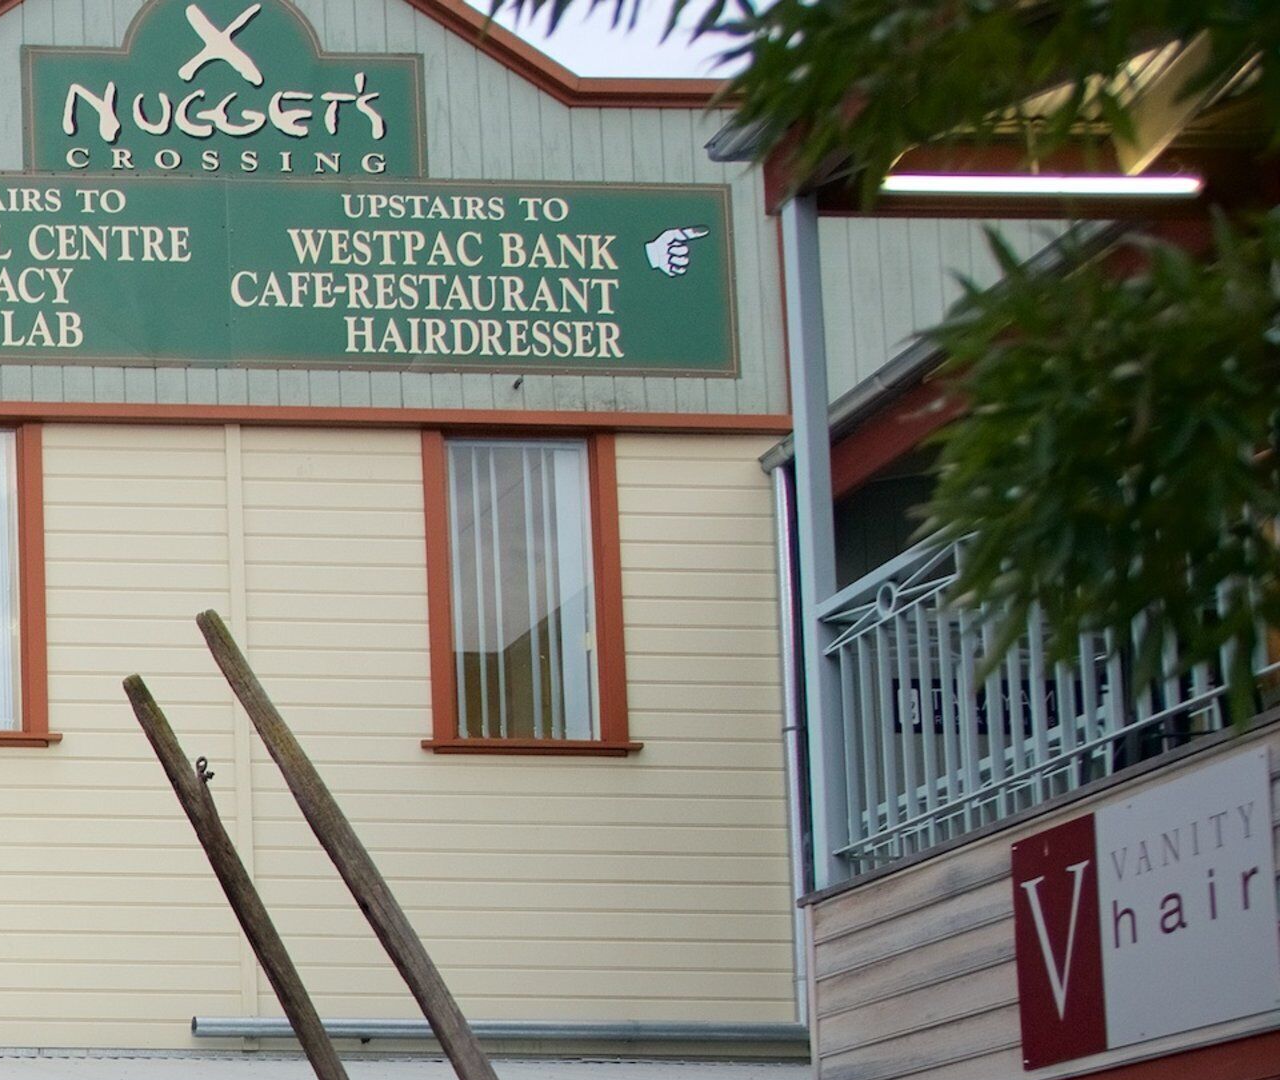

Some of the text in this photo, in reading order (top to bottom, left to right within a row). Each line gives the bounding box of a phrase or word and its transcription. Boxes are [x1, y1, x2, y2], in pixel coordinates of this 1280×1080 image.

[65, 147, 387, 173] CROSSING
[76, 189, 126, 213] TO
[341, 194, 569, 222] UPSTAIRS TO
[28, 224, 192, 262] CENTRE
[287, 228, 619, 270] WESTPAC BANK
[230, 271, 620, 315] CAFE-RESTAURANT
[0, 310, 84, 348] LAB
[344, 316, 624, 358] HAIRDRESSER
[1110, 801, 1255, 881] VANITY
[1112, 866, 1259, 949] hair
[1020, 859, 1090, 1022] V
